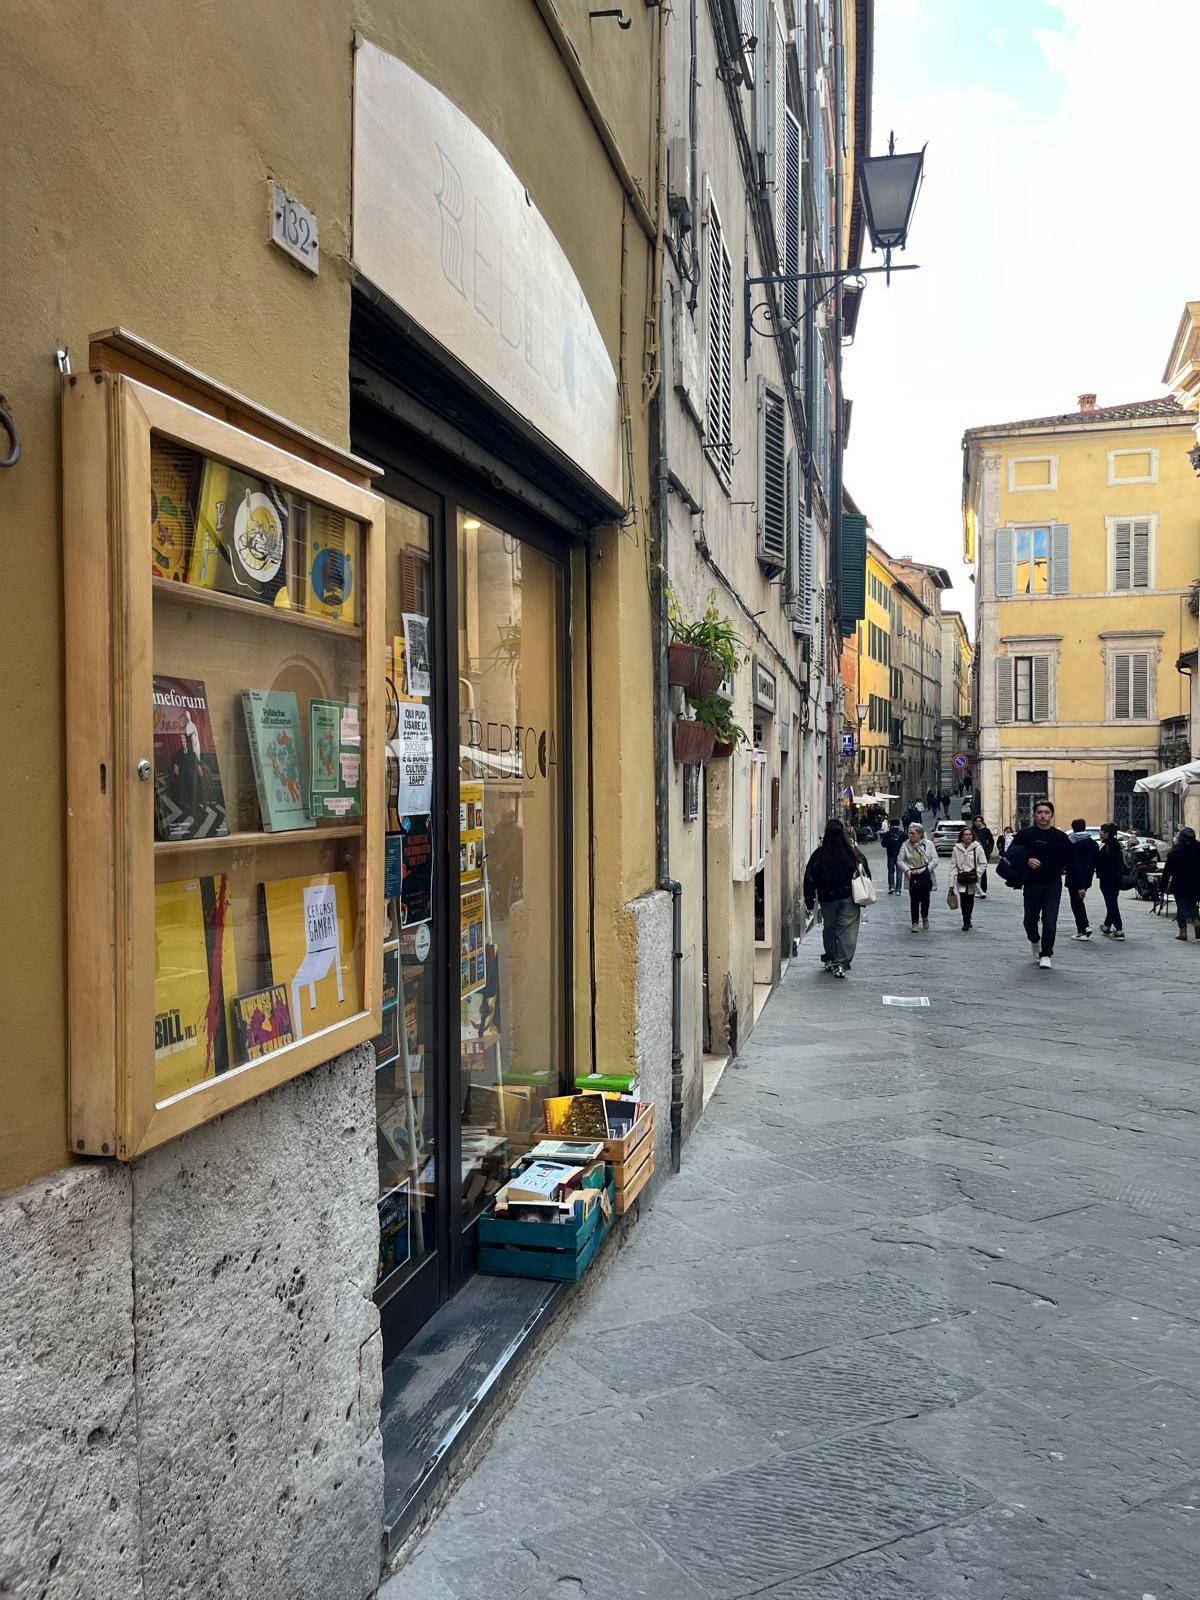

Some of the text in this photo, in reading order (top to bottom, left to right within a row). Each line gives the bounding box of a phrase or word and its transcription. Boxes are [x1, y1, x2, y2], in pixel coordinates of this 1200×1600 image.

[280, 204, 310, 256] 132
[434, 141, 590, 413] REBECC
[152, 688, 207, 710] ineforum
[262, 708, 286, 717] Politiche
[405, 709, 427, 720] QUI PUOI
[404, 720, 428, 731] USARE LA
[404, 742, 427, 752] DOCENTE
[405, 764, 428, 774] CULTURA
[408, 775, 425, 785] 18APP
[307, 902, 334, 918] CERCASI
[308, 914, 337, 942] GAMBA!
[154, 1014, 184, 1050] BILL
